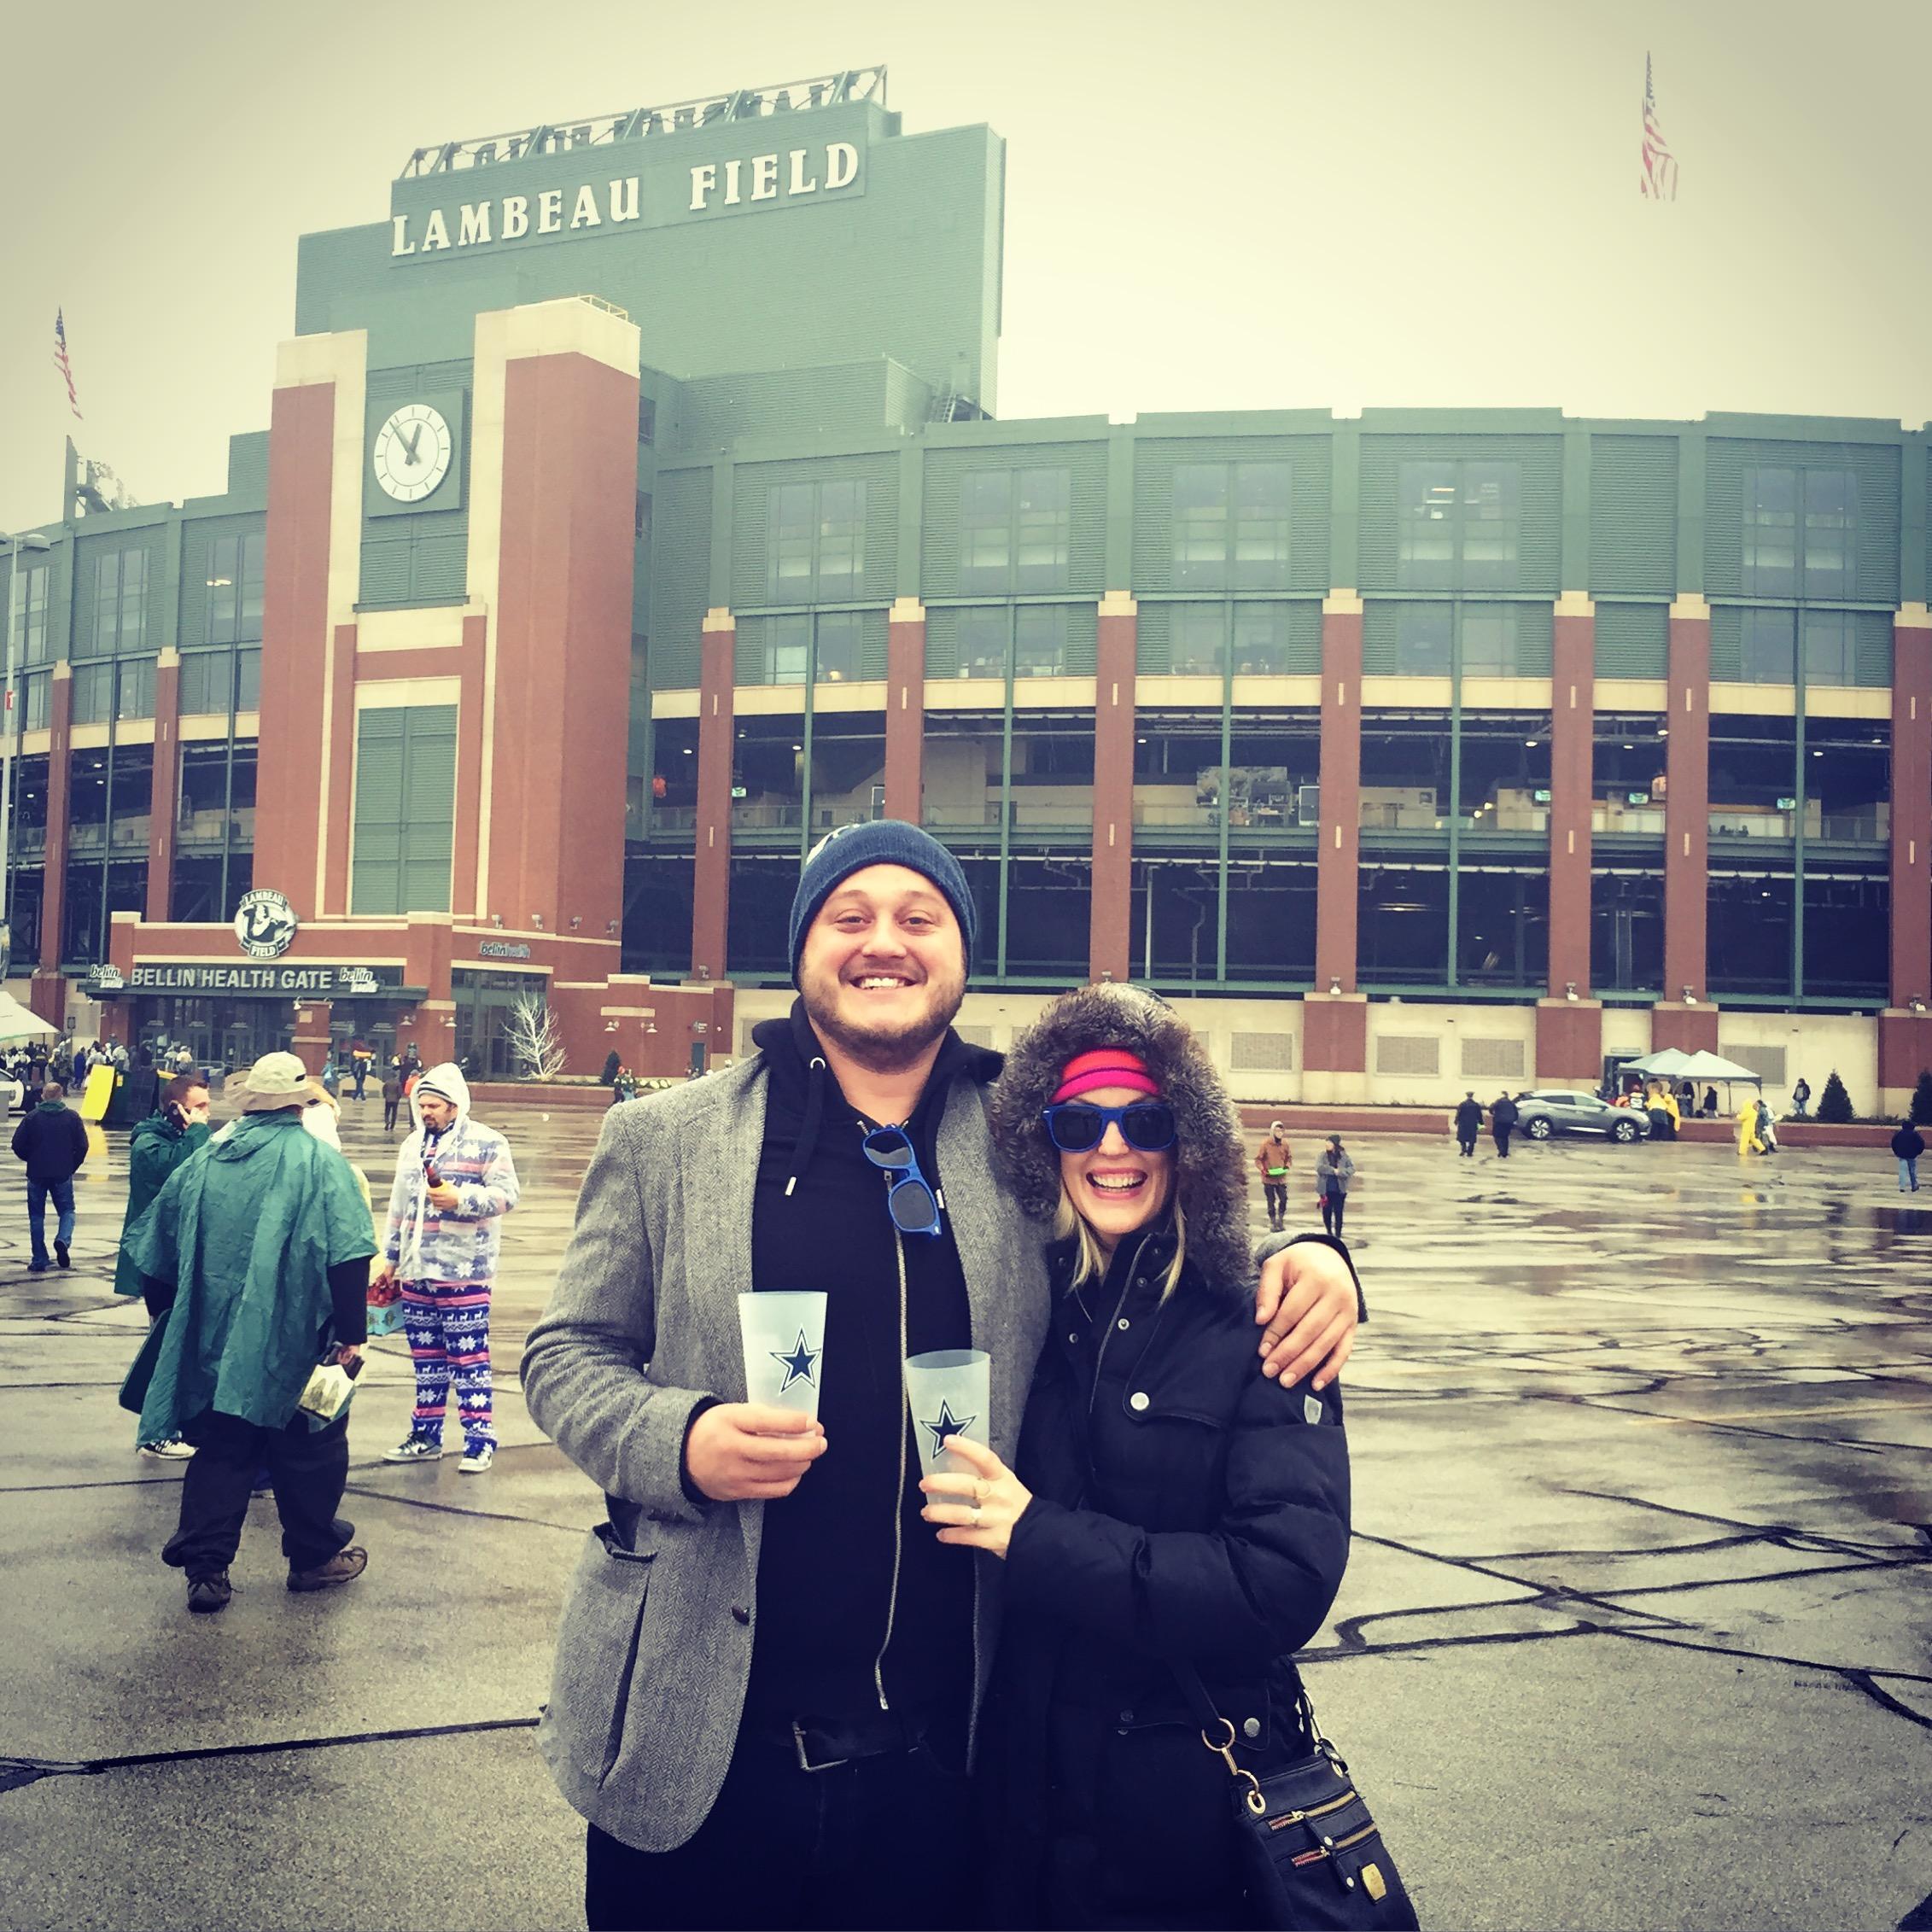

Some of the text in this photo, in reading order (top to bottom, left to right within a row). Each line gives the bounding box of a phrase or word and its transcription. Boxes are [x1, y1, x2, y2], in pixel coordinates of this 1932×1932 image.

[391, 177, 640, 257] LAMBEAU
[689, 142, 859, 211] FIELD
[244, 890, 285, 906] LAMBEAU
[250, 945, 277, 957] FIELD
[131, 968, 196, 987] BELLIN
[201, 969, 275, 989] HEALTH
[281, 970, 333, 989] GATE
[339, 966, 374, 982] bellin
